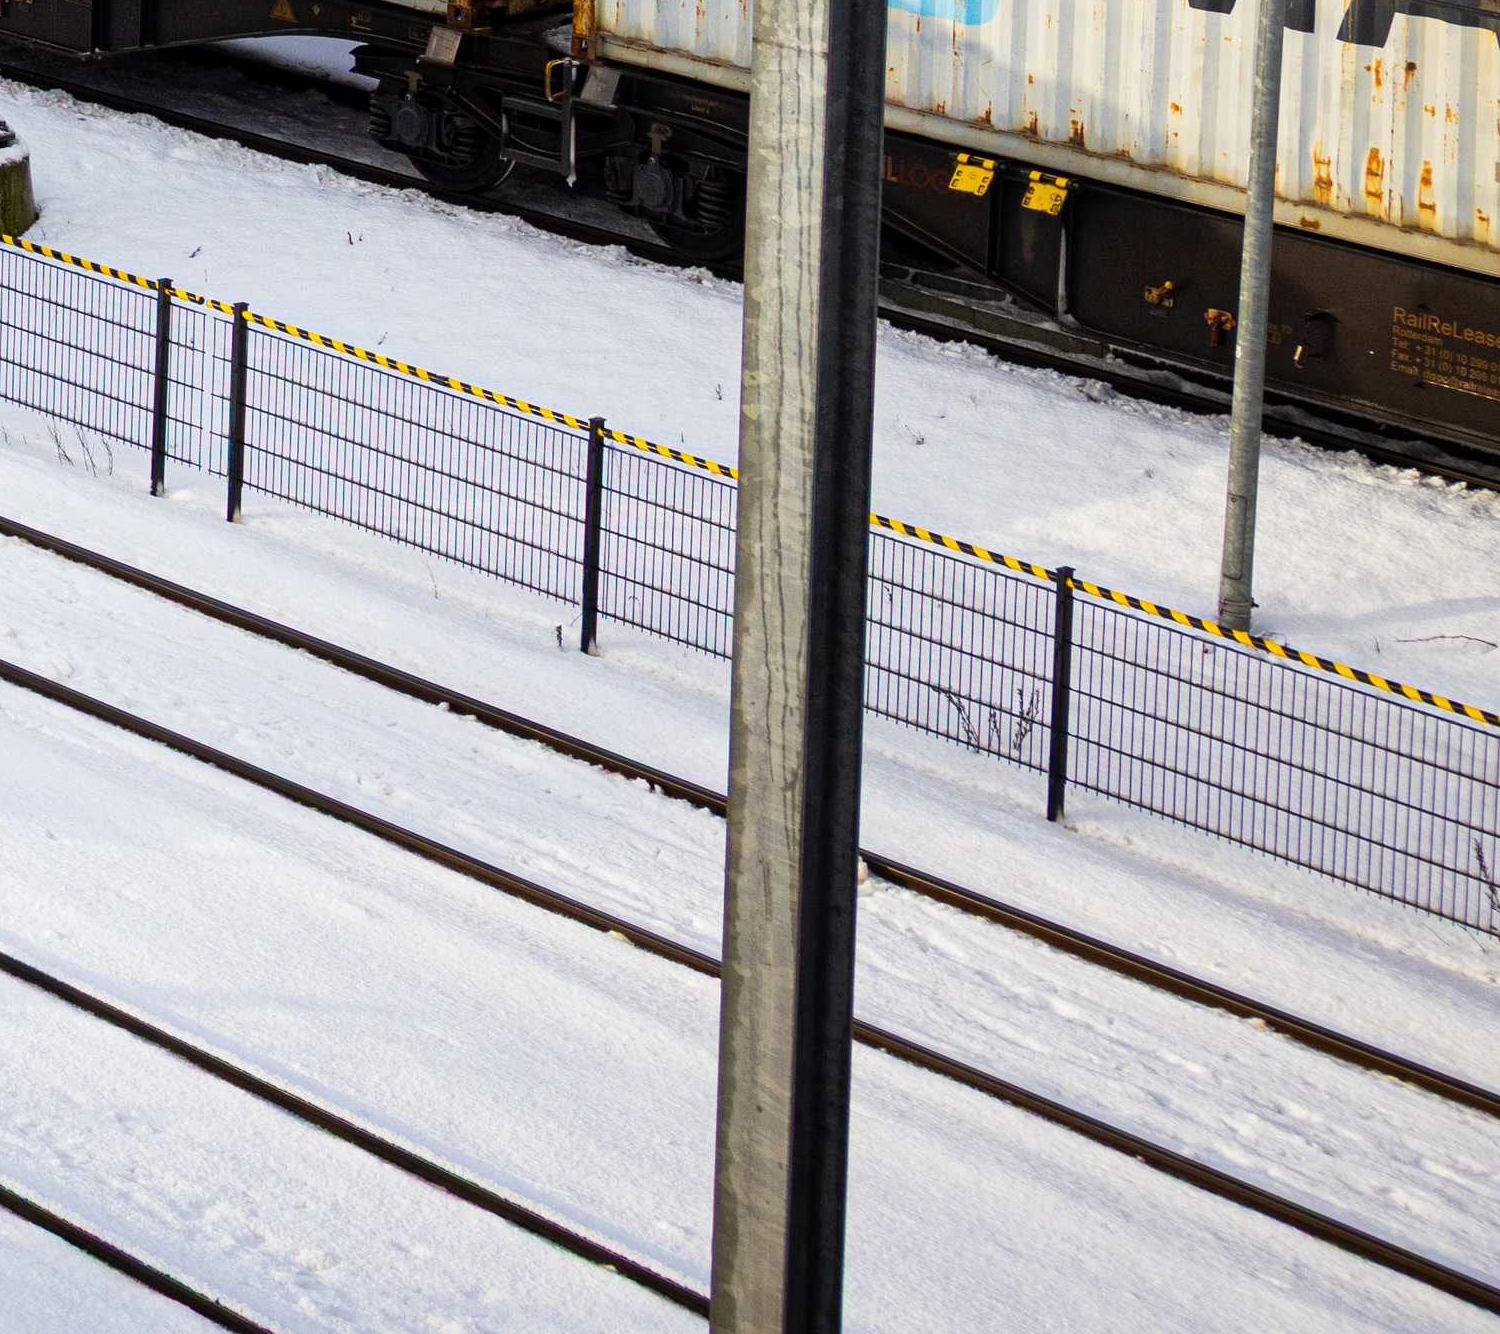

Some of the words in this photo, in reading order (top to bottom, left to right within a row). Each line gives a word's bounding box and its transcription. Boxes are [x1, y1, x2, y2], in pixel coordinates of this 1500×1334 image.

[1391, 324, 1443, 346] Rotterdam
[1424, 345, 1436, 356] 31
[1439, 349, 1453, 362] (0)
[1470, 356, 1489, 370] 299
[1424, 357, 1435, 368] 31
[1438, 361, 1452, 374] (0)
[1469, 368, 1488, 382] 299
